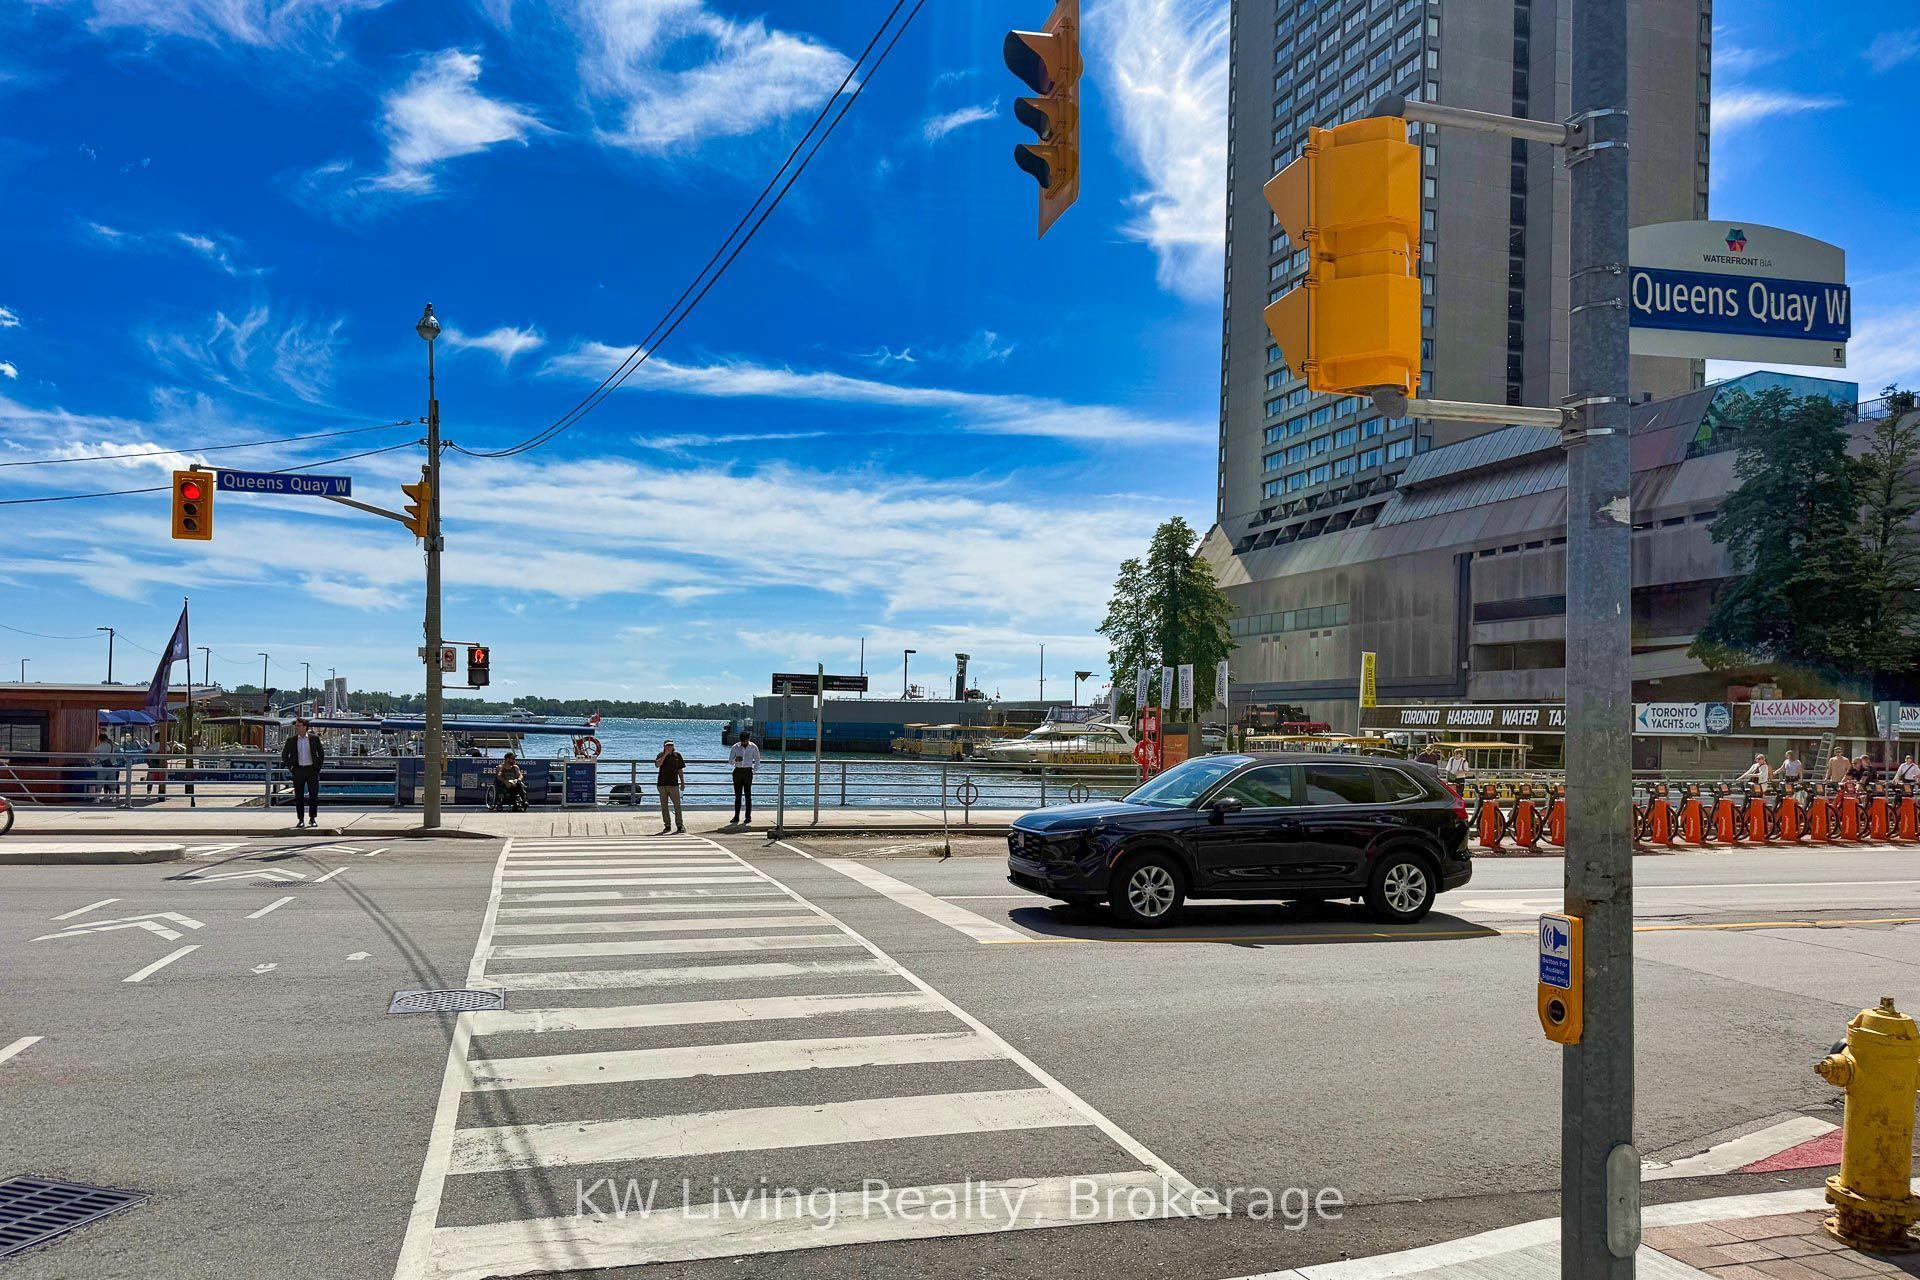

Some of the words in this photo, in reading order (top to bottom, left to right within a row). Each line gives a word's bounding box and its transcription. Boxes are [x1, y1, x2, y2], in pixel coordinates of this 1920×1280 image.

[1703, 254, 1759, 266] WATERFRONT
[1760, 259, 1772, 267] BIA
[1632, 272, 1739, 317] Queens
[1748, 282, 1817, 332] Quay
[1824, 288, 1847, 325] W
[223, 473, 284, 490] Queens
[290, 477, 329, 495] Quay
[335, 479, 347, 492] W
[1651, 707, 1698, 717] TORONTO
[1753, 701, 1836, 716] ALEXANDROS
[1400, 710, 1440, 725] TORONTO
[1446, 709, 1493, 725] HARBOUR
[1501, 709, 1539, 726] WATER
[1651, 719, 1700, 728] YACHTS.COM
[1542, 957, 1558, 966] Button
[1542, 973, 1557, 981] Signal
[1557, 976, 1568, 987] Only
